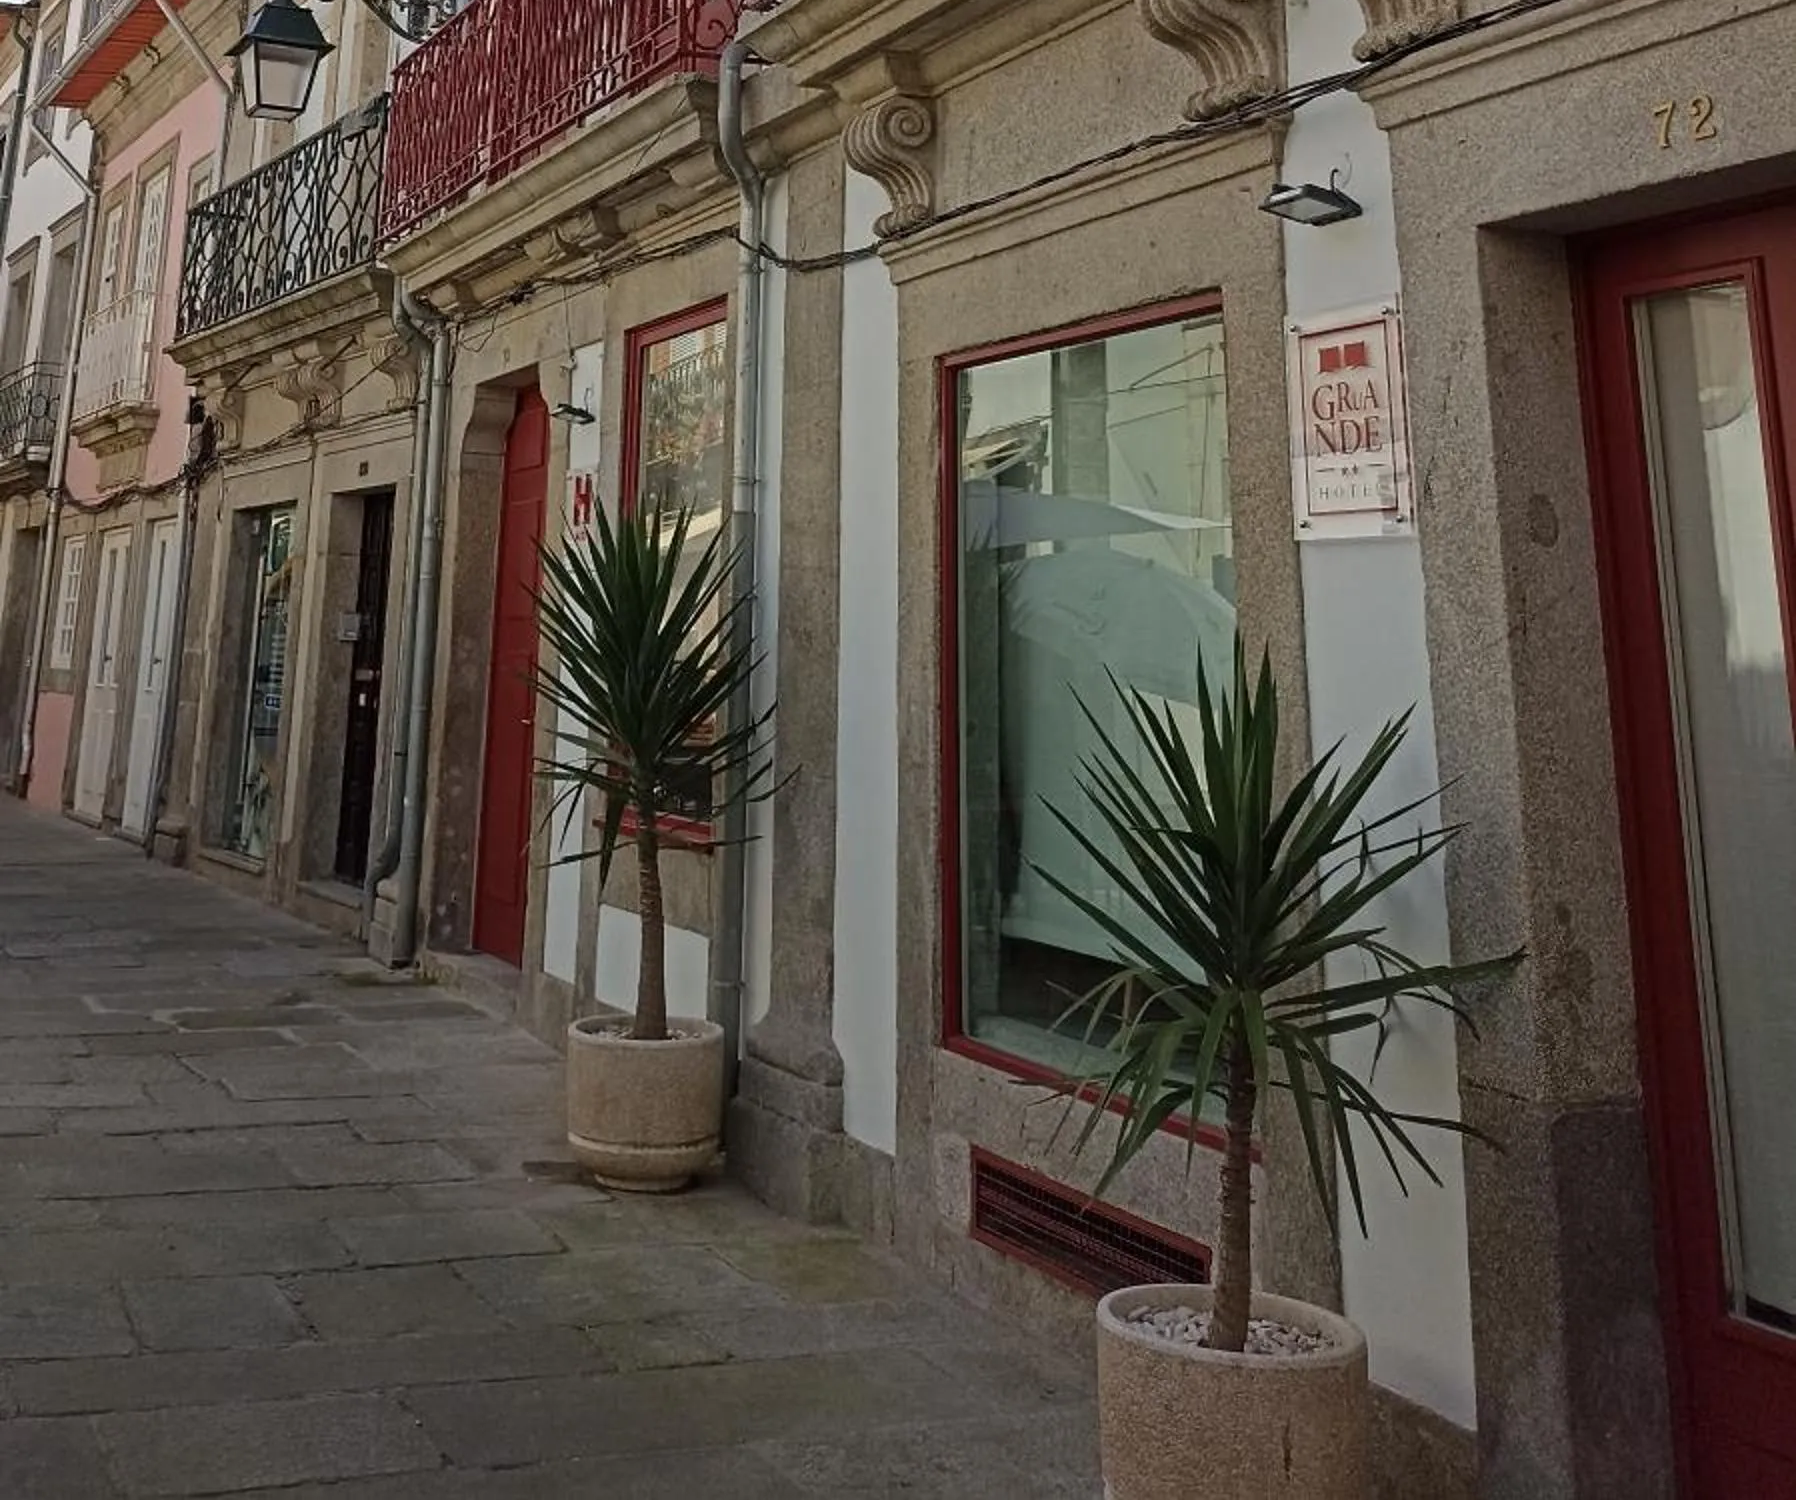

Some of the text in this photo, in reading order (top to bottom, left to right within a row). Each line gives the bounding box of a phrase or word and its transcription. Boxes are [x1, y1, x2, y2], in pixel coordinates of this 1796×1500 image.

[1653, 92, 1717, 149] 72
[1314, 416, 1383, 457] NDE
[574, 474, 592, 526] H
